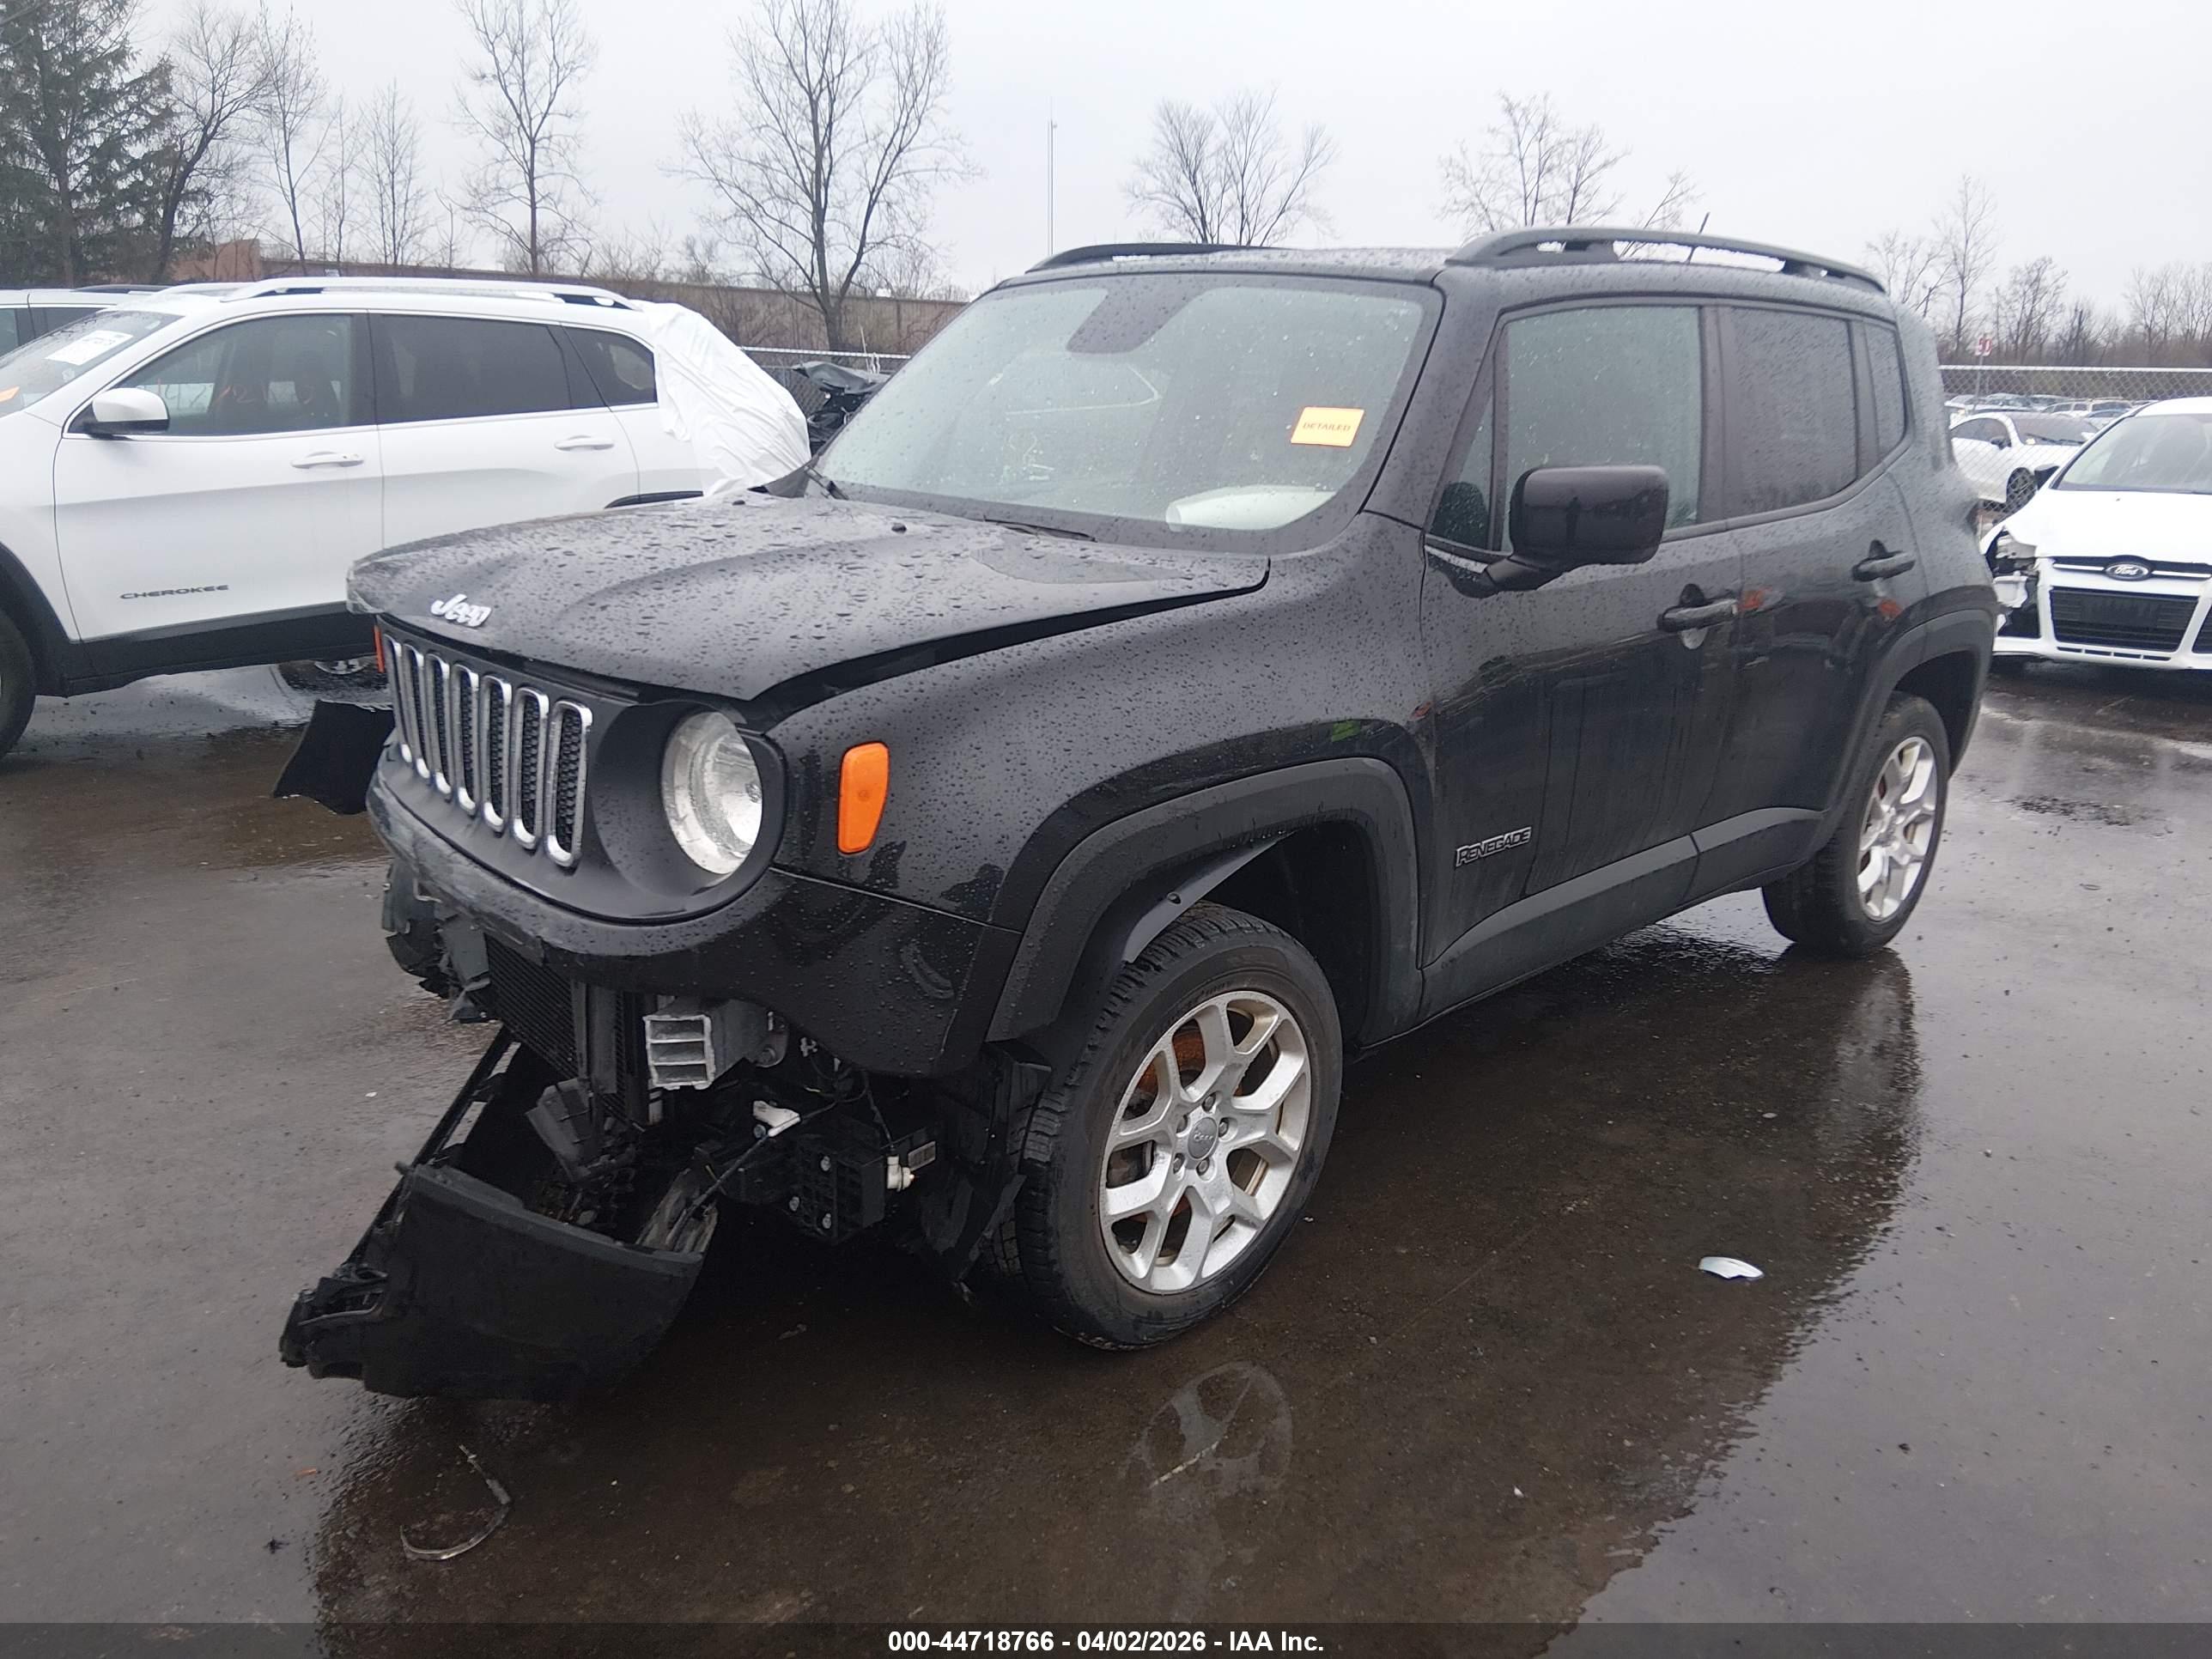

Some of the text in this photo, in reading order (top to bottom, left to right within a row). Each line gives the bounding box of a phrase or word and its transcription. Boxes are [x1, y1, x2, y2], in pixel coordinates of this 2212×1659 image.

[1302, 422, 1352, 432] DETAILED
[2113, 564, 2139, 576] Ford
[120, 585, 228, 599] CHEROKEE
[430, 593, 491, 627] Jeep
[1455, 826, 1532, 867] RENEGADE
